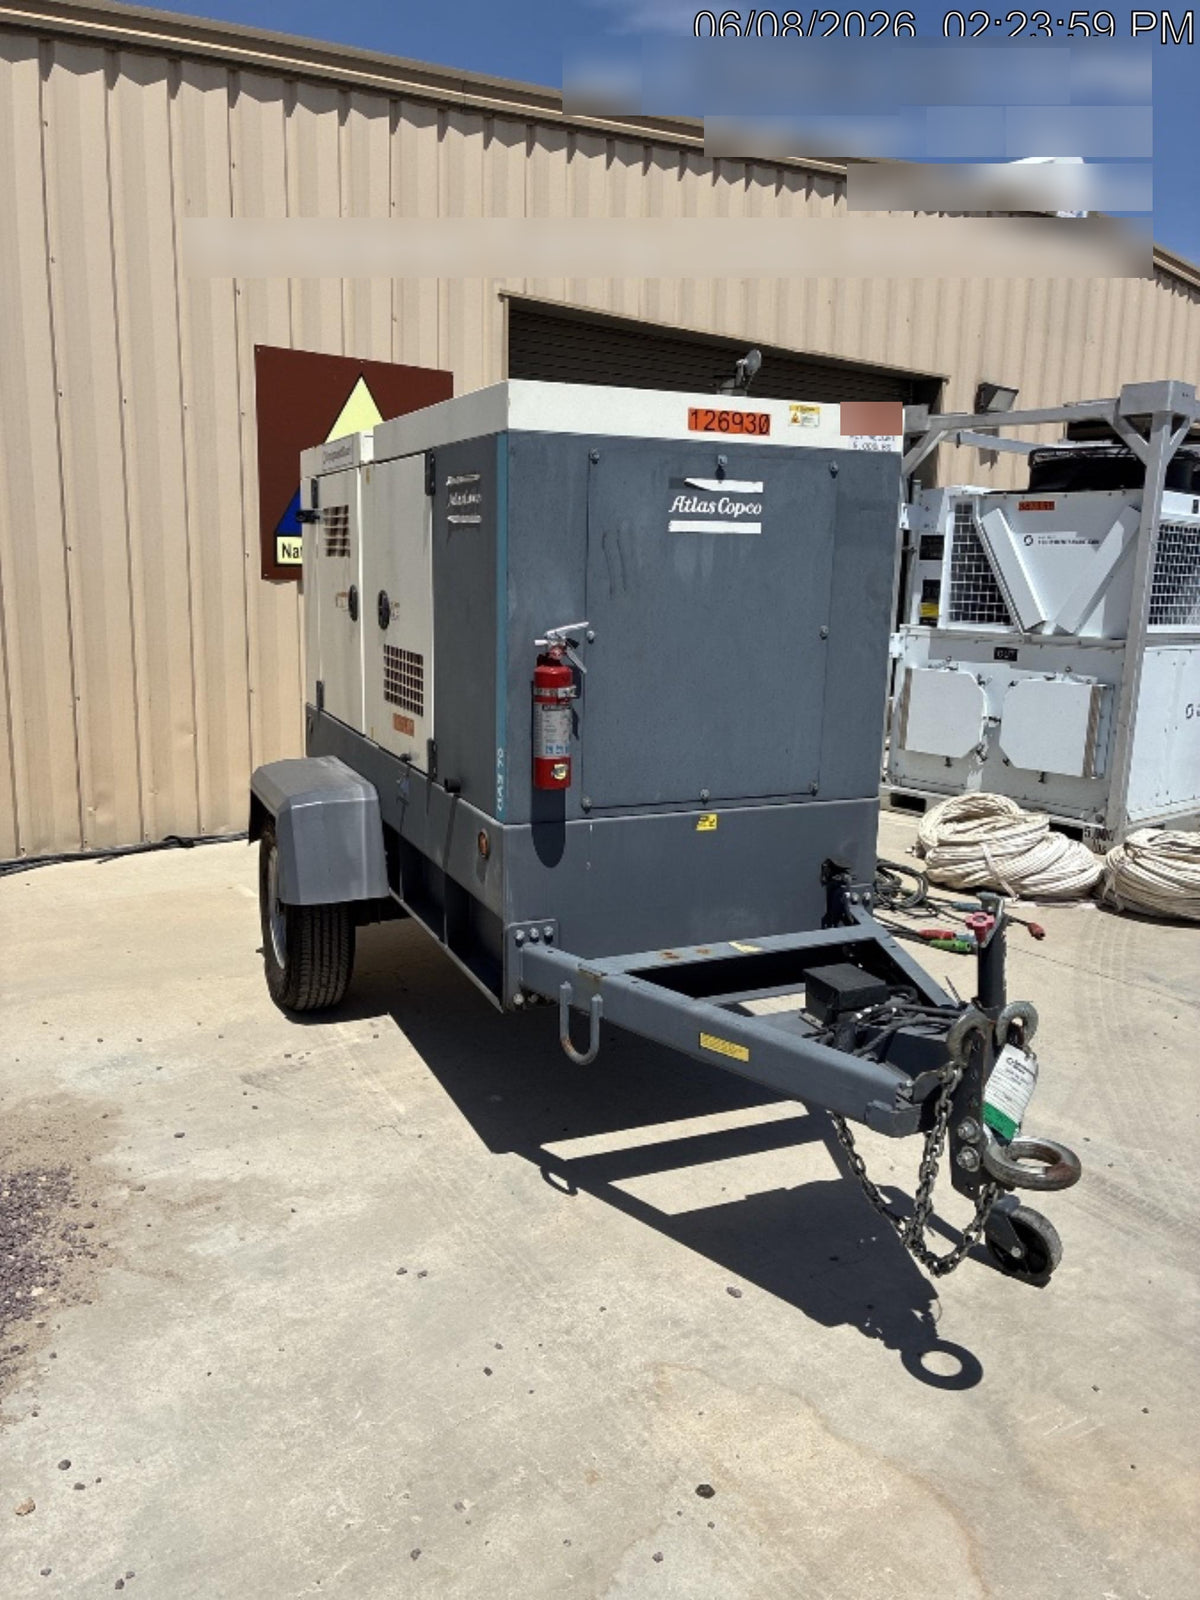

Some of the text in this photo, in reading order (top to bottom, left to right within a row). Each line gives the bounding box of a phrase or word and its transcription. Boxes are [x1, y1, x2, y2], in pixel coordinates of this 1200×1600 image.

[691, 409, 770, 435] 126930
[668, 495, 762, 518] Atlas Copco
